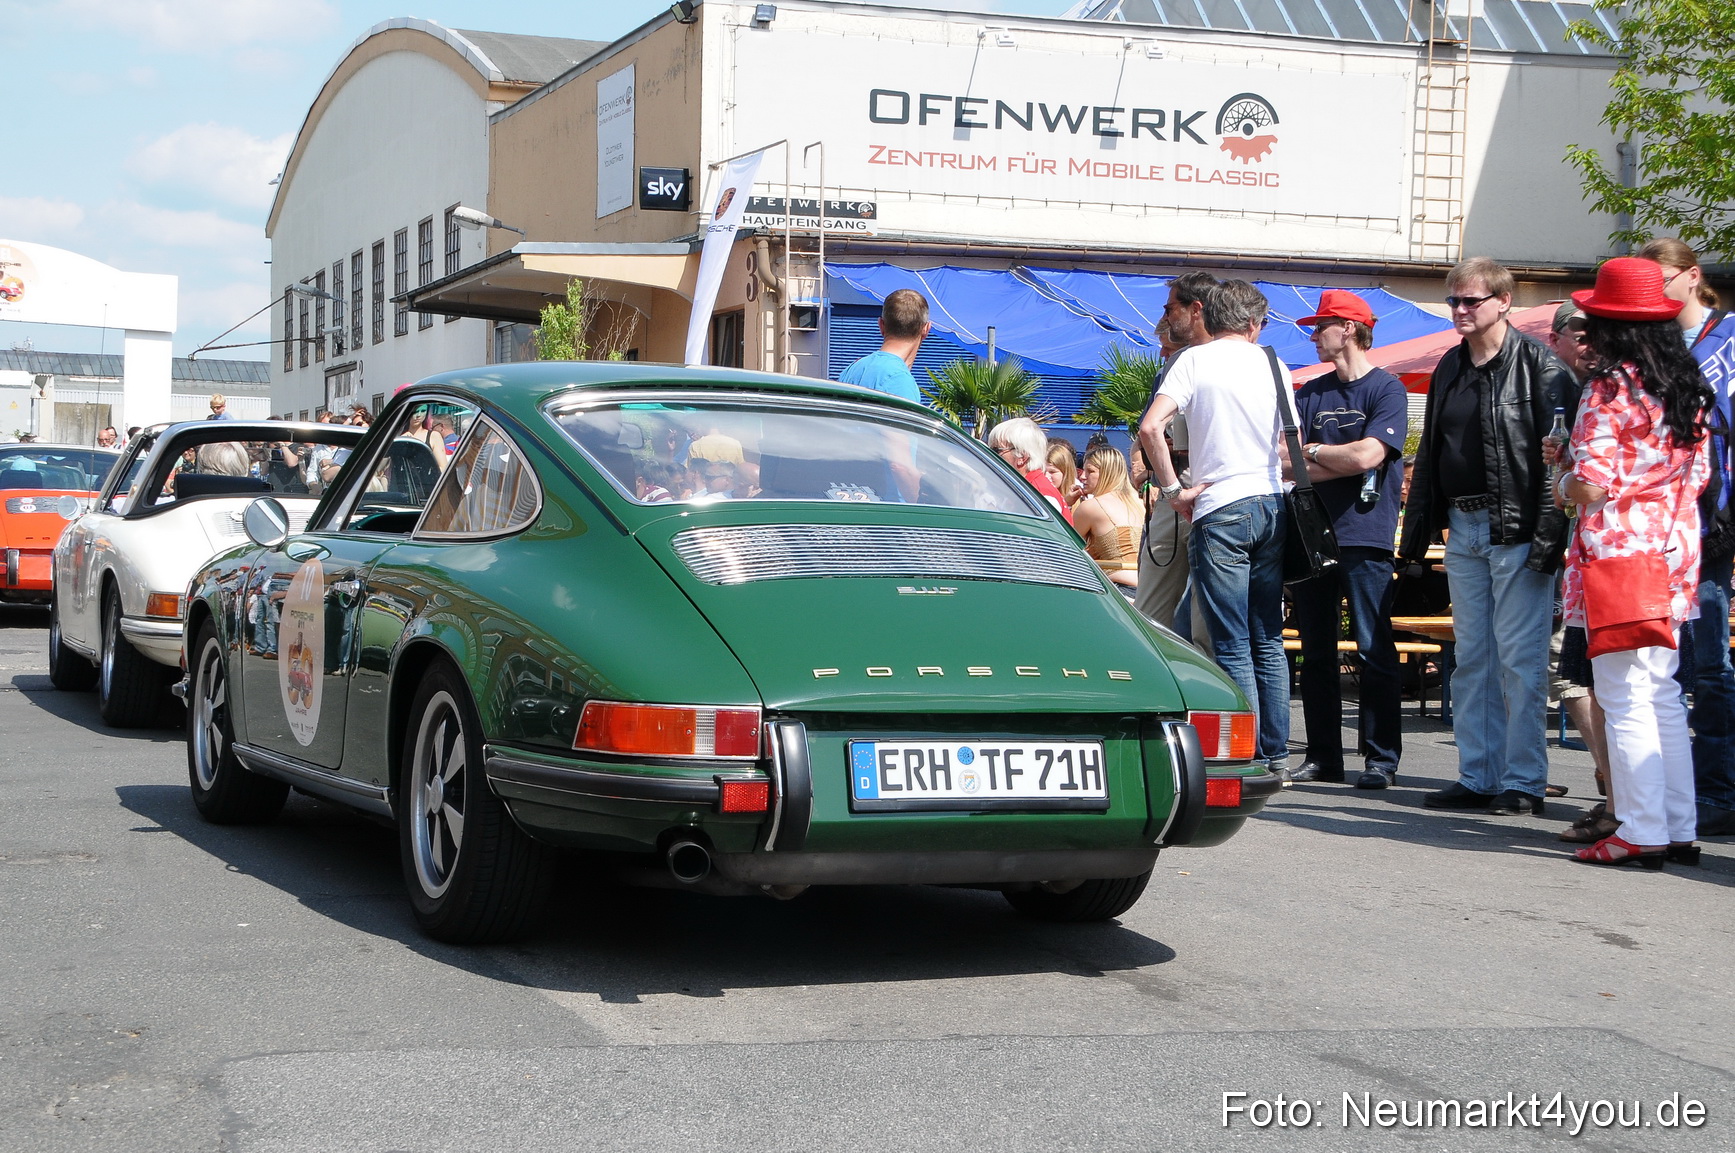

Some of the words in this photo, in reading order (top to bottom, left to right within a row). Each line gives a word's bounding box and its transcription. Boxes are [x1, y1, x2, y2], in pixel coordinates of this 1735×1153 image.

[869, 88, 1209, 146] OFENWERK
[868, 145, 997, 171] ZENTRUM
[1007, 151, 1057, 175] FÜR
[1068, 157, 1164, 181] MOBILE
[1174, 164, 1280, 188] CLASSIC
[647, 176, 684, 201] sky
[753, 197, 855, 211] FENWERK
[742, 215, 867, 230] HAUPTEINGANG
[746, 251, 759, 303] 3
[812, 665, 1133, 681] PORSCHE
[878, 748, 952, 791] ERH
[980, 748, 1023, 790] TF
[1034, 749, 1102, 790] 71H
[860, 776, 870, 790] D
